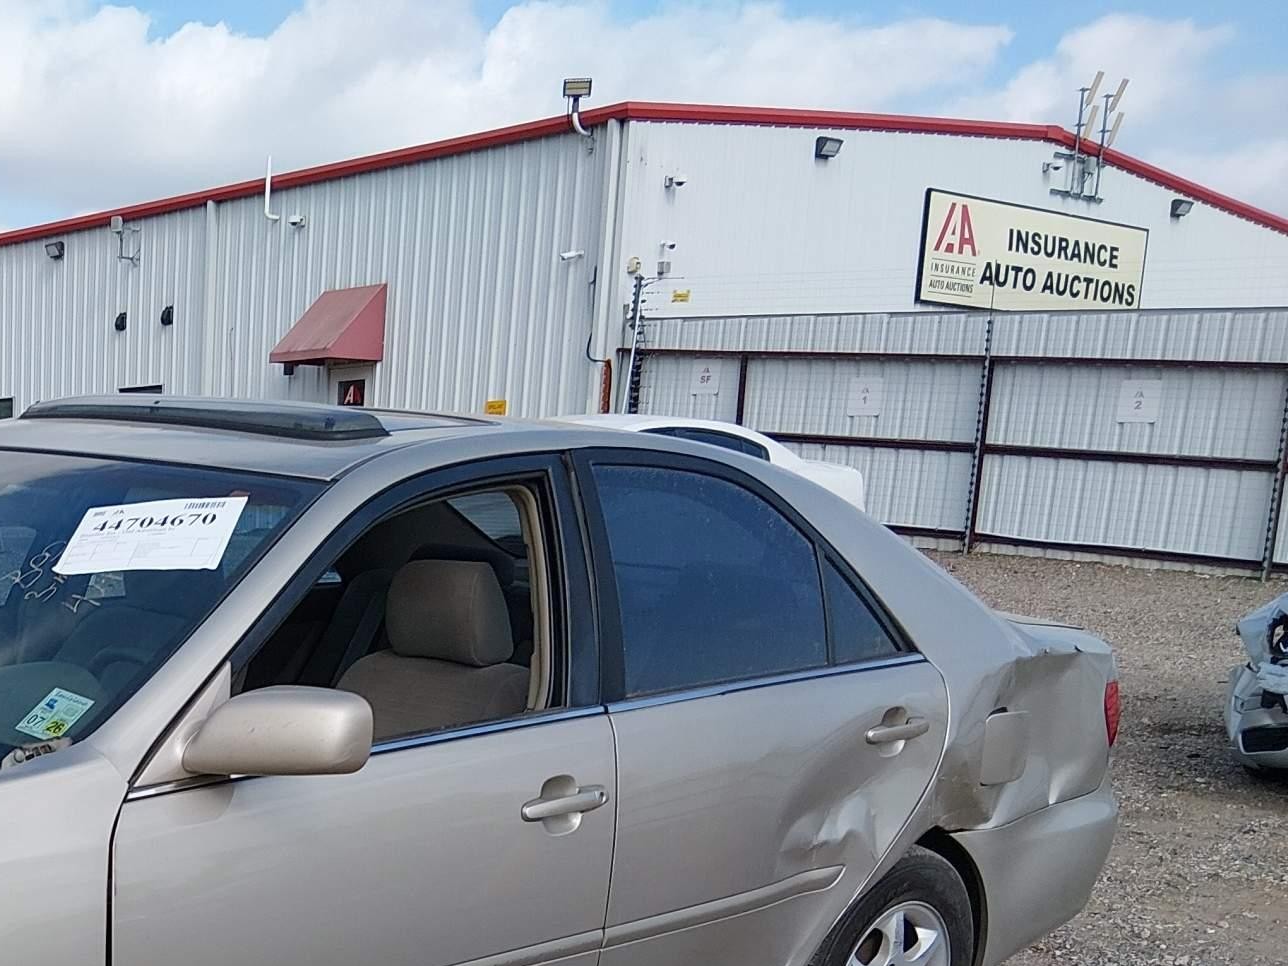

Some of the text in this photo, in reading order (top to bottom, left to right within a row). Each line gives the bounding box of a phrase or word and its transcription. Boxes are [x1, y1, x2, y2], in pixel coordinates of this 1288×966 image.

[1008, 228, 1120, 270] INSURANCE
[930, 262, 977, 277] INSURANCE
[928, 279, 974, 294] AUTO AUCTIONS
[979, 261, 1136, 307] AUTO AUCTIONS
[700, 375, 712, 384] SF
[1134, 400, 1143, 410] 2
[93, 513, 217, 531] 44704670
[26, 714, 46, 728] 07
[45, 721, 66, 734] 26
